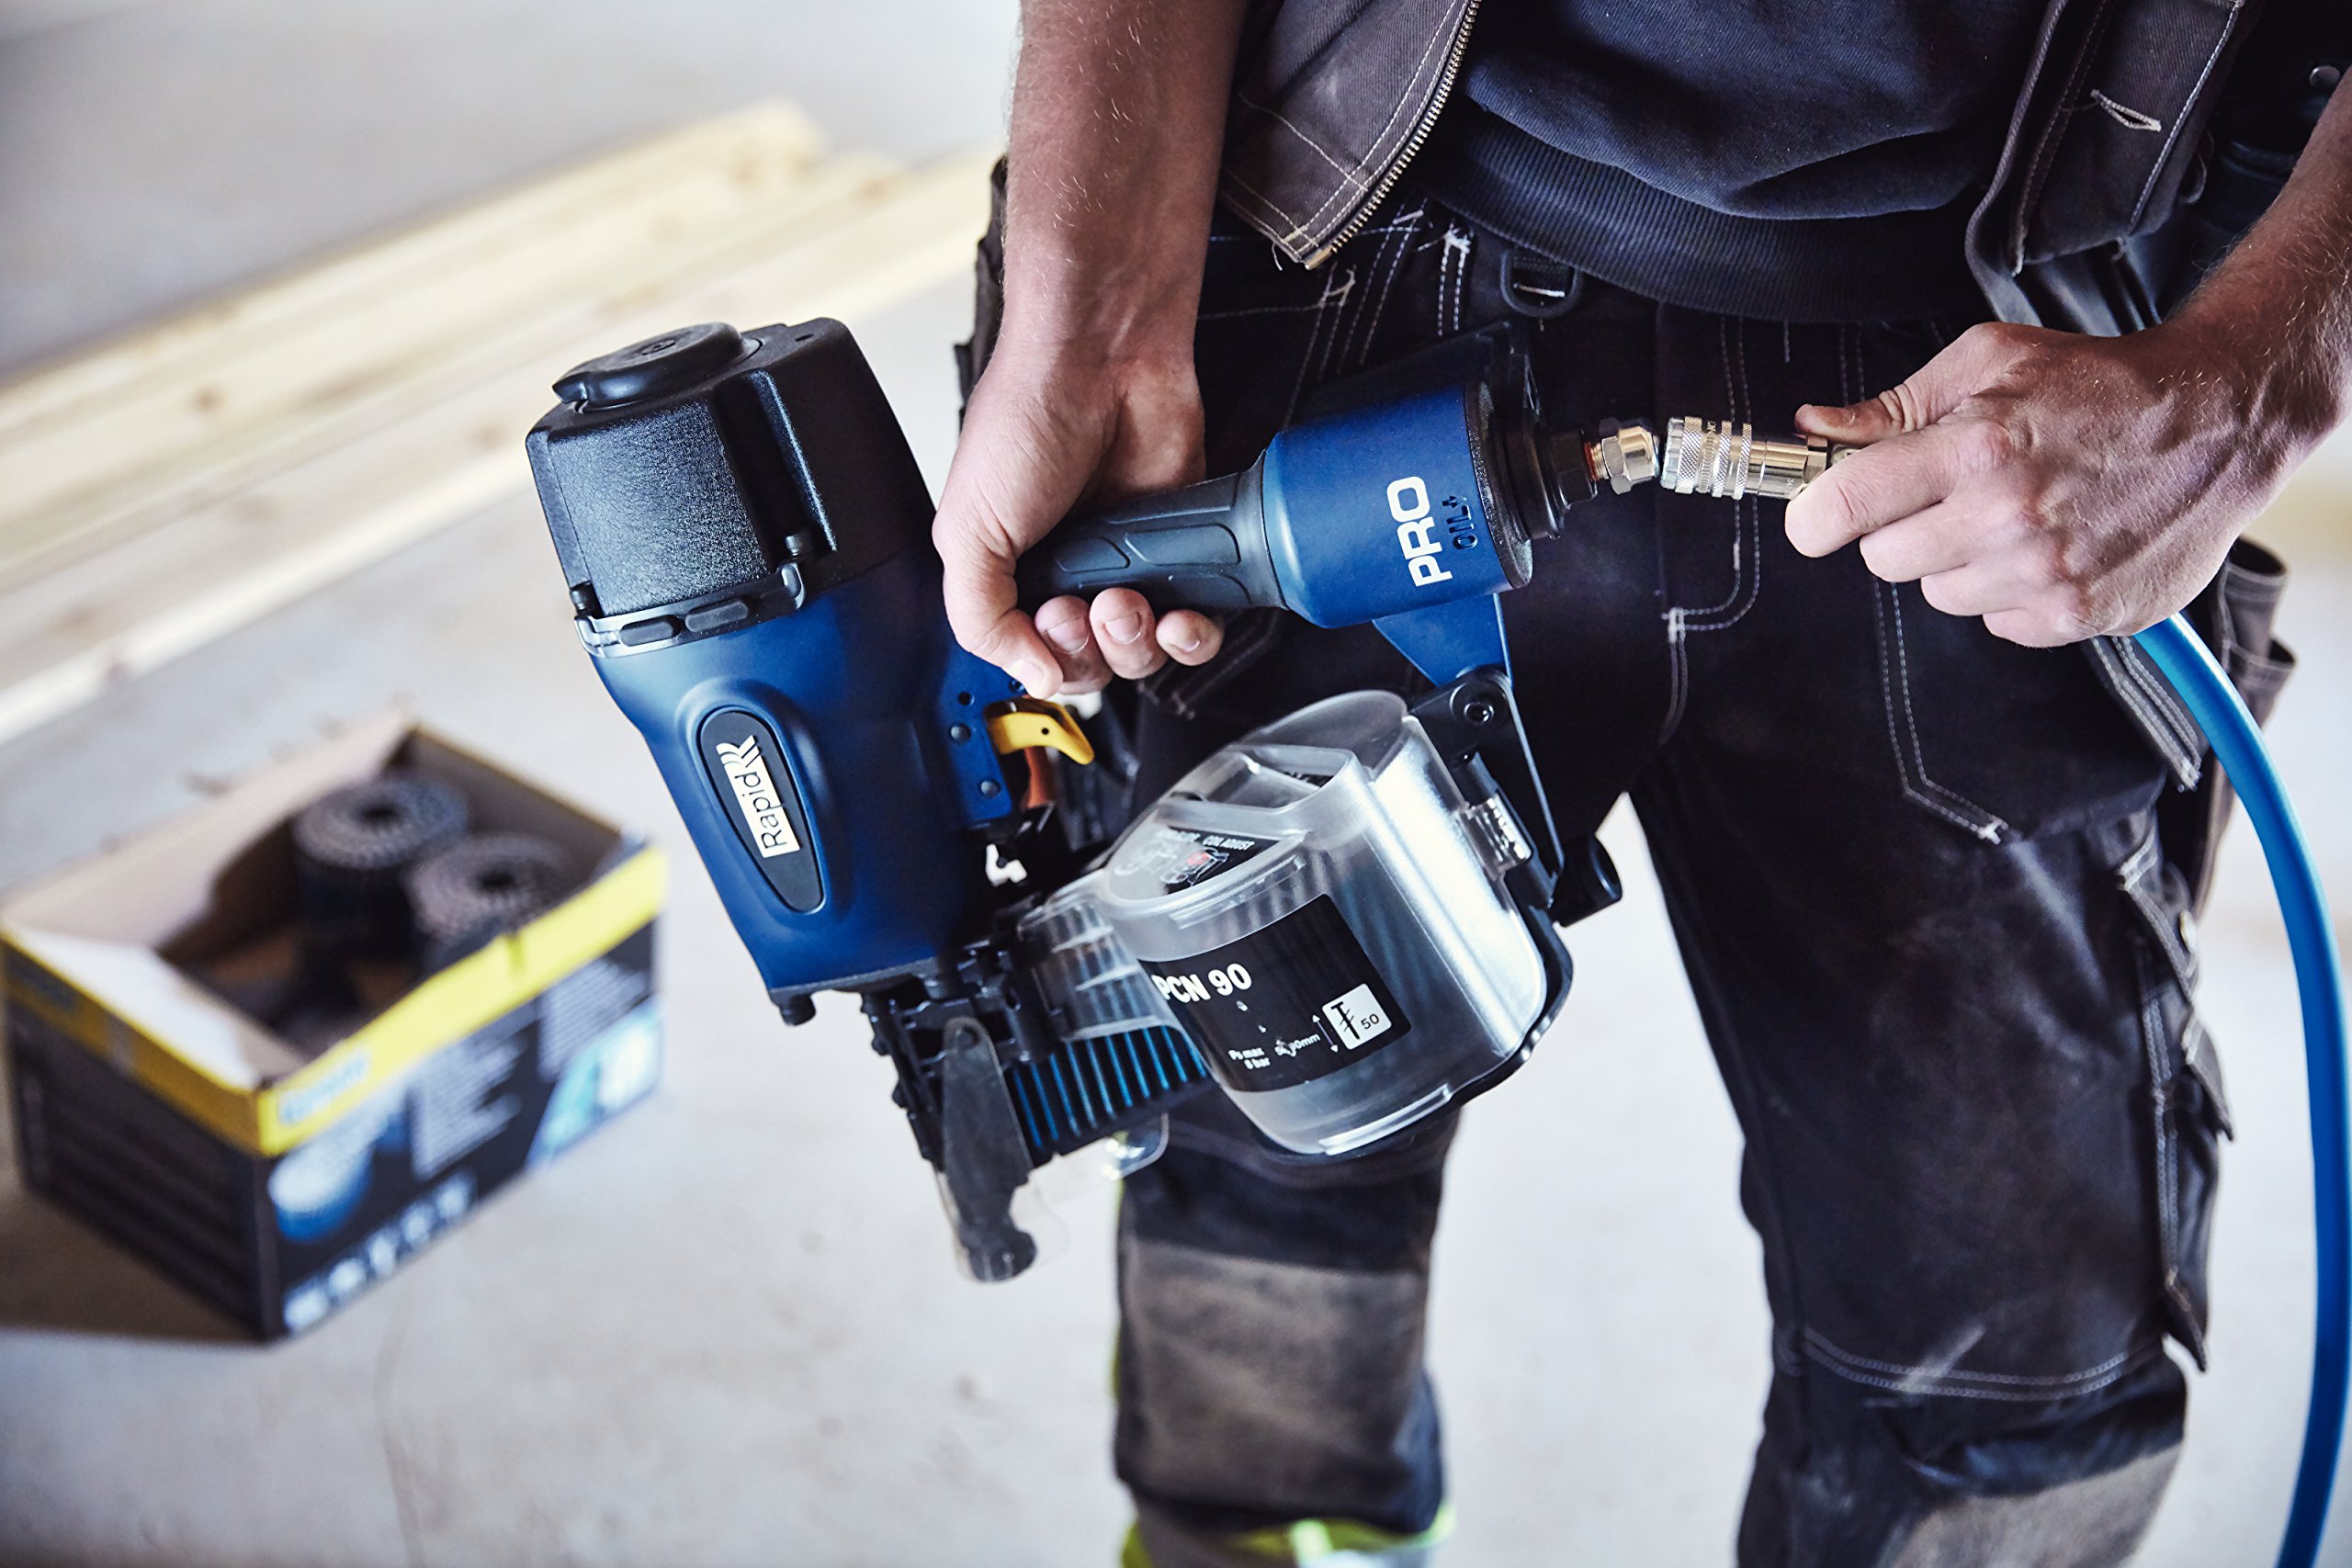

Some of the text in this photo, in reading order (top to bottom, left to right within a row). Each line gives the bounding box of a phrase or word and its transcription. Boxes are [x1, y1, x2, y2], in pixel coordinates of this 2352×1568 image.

[1386, 476, 1453, 587] PRO
[734, 771, 787, 849] Rapid
[1150, 963, 1252, 1003] PCN 90
[1361, 1013, 1380, 1030] 50
